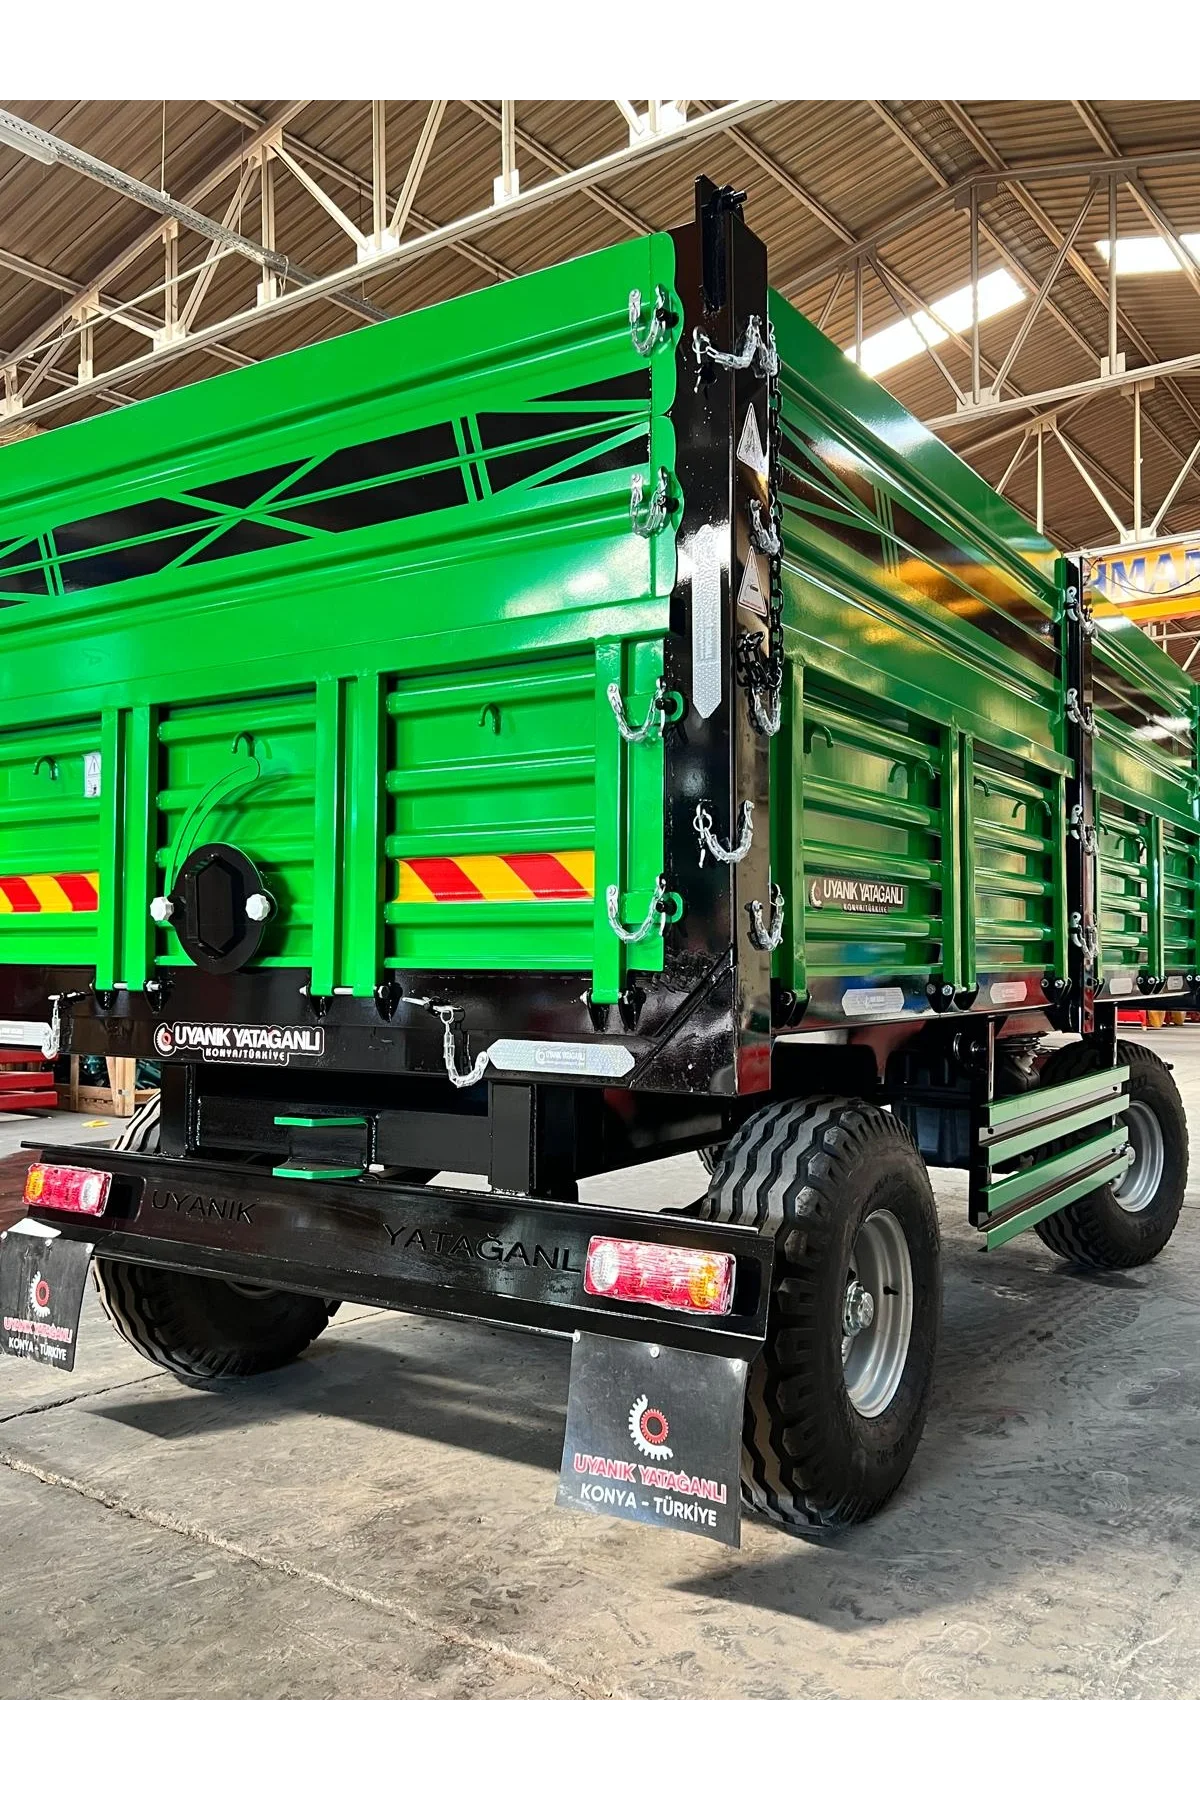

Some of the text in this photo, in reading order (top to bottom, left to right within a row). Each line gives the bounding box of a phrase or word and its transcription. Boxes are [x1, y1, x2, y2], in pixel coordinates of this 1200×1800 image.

[175, 1025, 232, 1047] UYANIK
[151, 1189, 257, 1224] UYANIK
[382, 1222, 582, 1275] YATAĞANL
[8, 1336, 34, 1353] KONYA
[40, 1341, 67, 1361] TÜRKİYE
[573, 1452, 637, 1484] UYANIK
[580, 1482, 637, 1509] KONYA
[653, 1495, 717, 1527] TÜRKİYE
